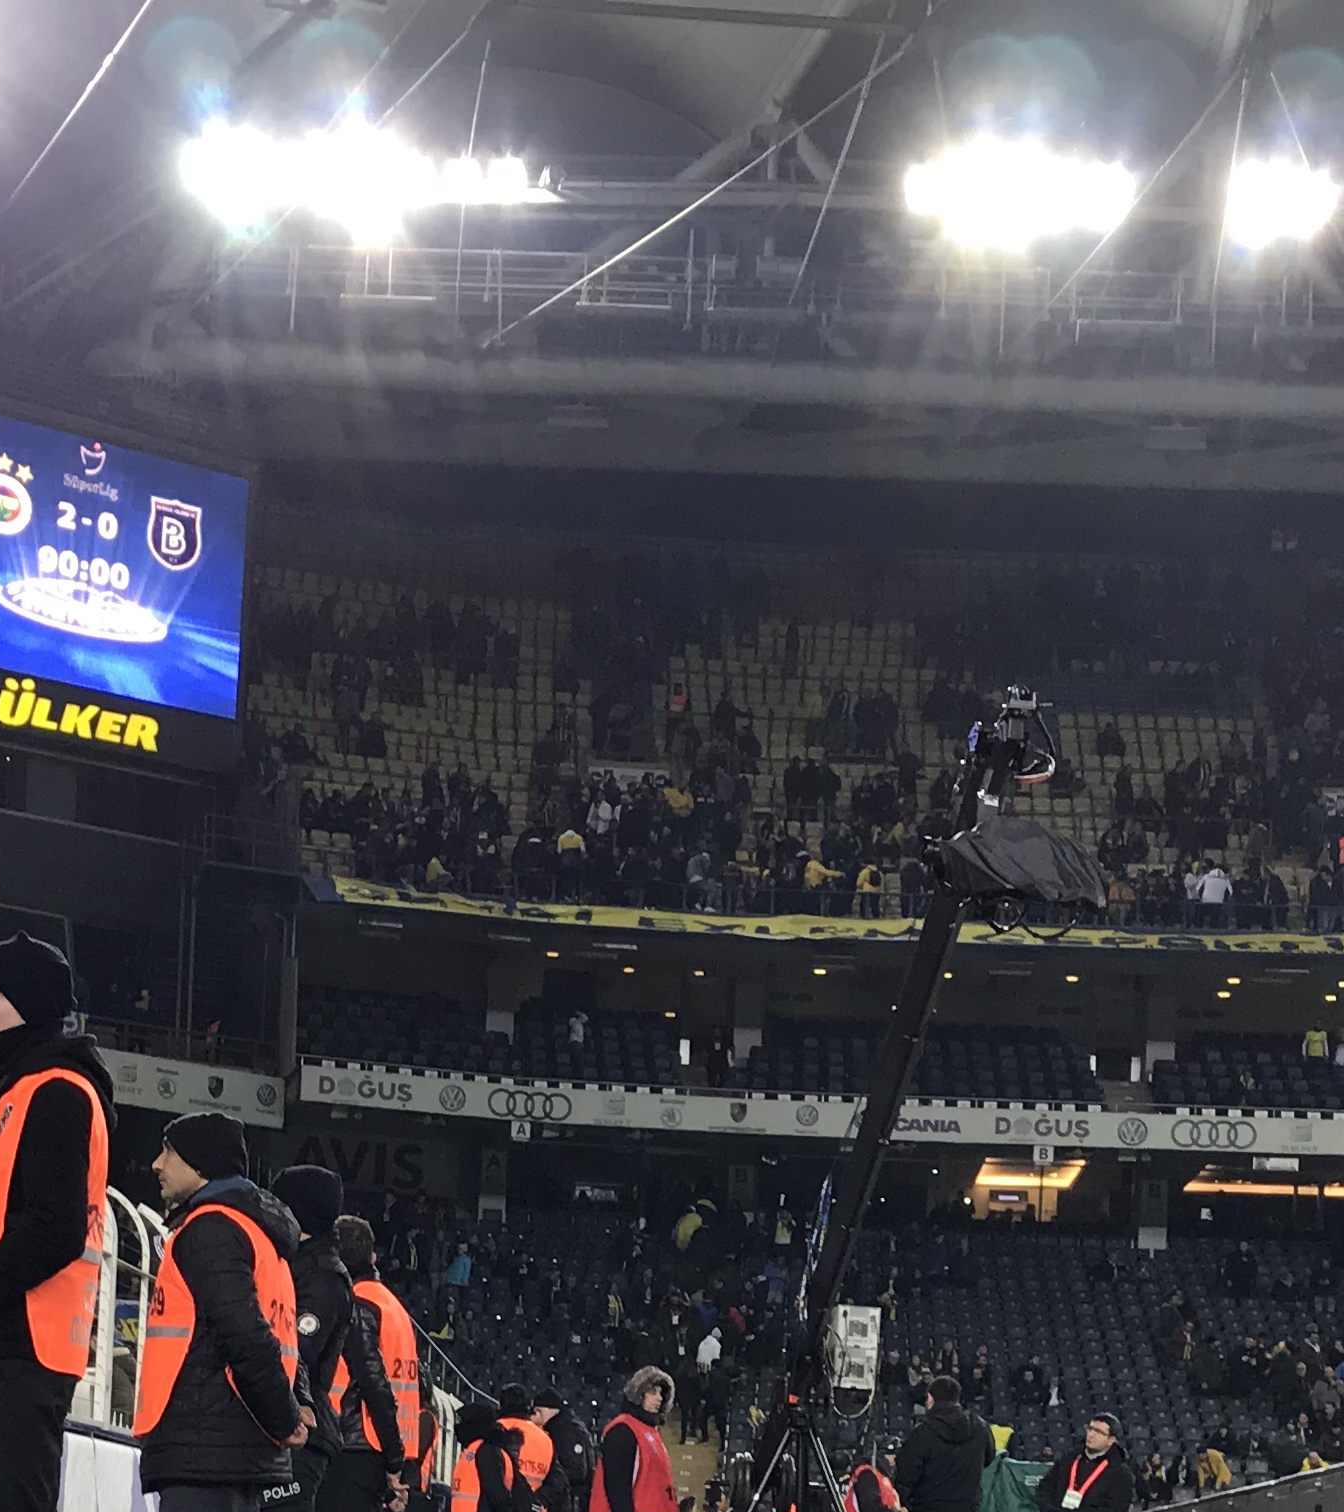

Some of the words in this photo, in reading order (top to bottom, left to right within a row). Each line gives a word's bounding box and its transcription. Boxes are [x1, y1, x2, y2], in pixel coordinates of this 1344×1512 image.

[38, 545, 129, 589] 90:00
[892, 1117, 961, 1134] CANIA
[295, 1134, 424, 1190] AVIS
